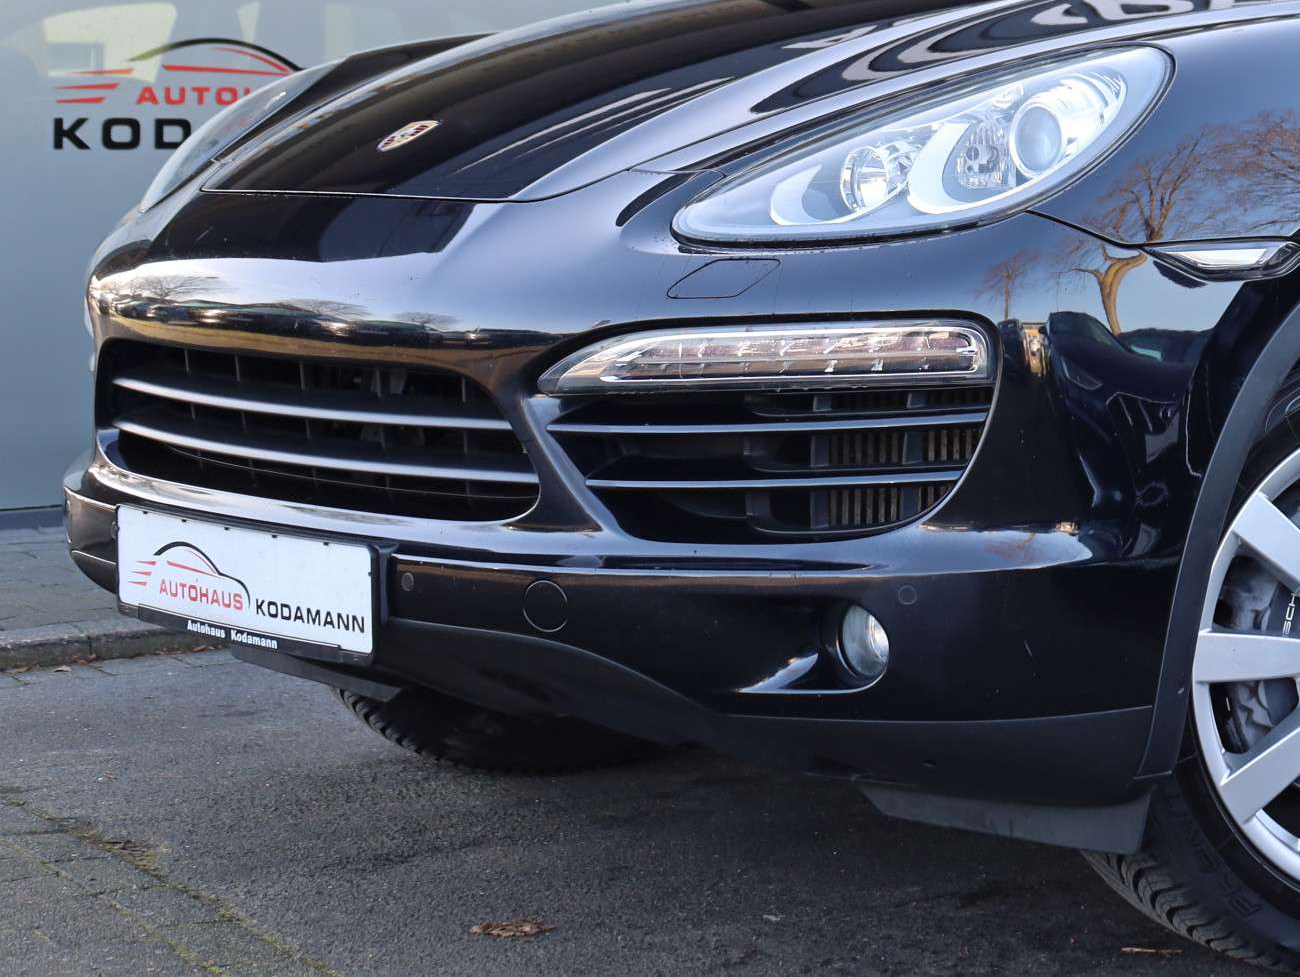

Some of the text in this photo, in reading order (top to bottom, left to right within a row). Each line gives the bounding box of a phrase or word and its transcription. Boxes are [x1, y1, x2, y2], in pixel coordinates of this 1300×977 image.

[158, 577, 365, 634] AUTOHAUS KODAMANN
[186, 619, 278, 650] Autohaus Kodamann
